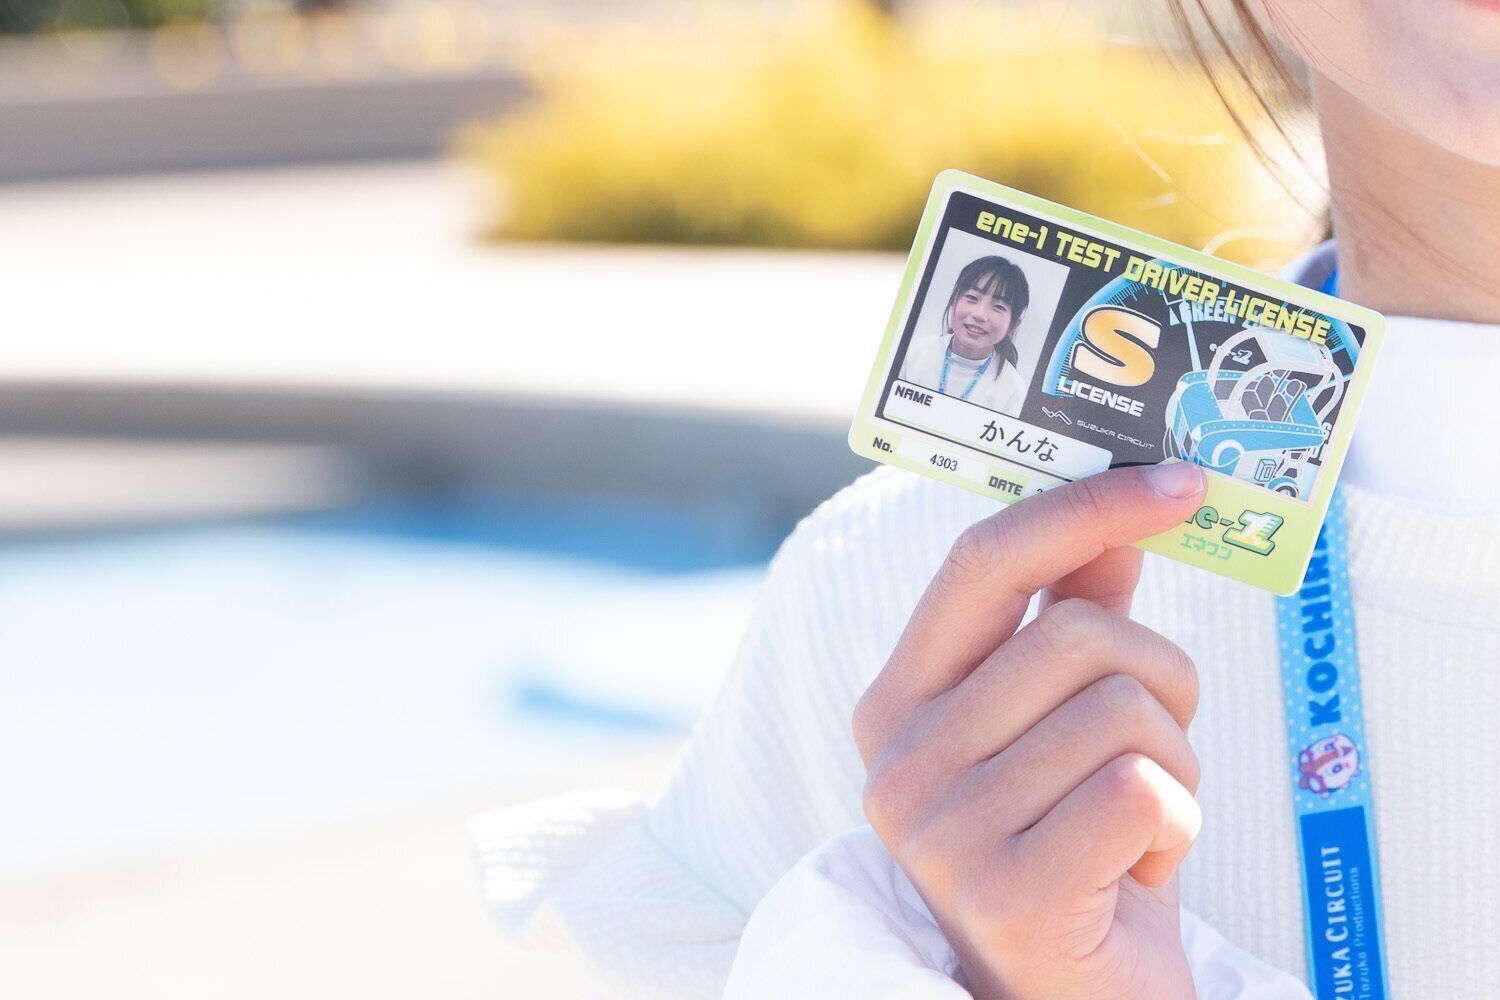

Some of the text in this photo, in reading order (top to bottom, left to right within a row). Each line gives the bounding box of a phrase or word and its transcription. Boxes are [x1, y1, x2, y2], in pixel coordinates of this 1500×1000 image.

[976, 210, 1332, 346] ene-1 TEST DRIVER LICENSE
[1069, 304, 1162, 387] S
[894, 385, 933, 407] NAME
[1057, 376, 1145, 417] LICENSE
[979, 420, 1059, 462] かんな
[1076, 419, 1155, 450] SUZUKA CIRCUIT
[872, 437, 1024, 497] No. 4303 DATE
[1321, 846, 1349, 942] CIRCUIT
[1350, 866, 1365, 947] Productions
